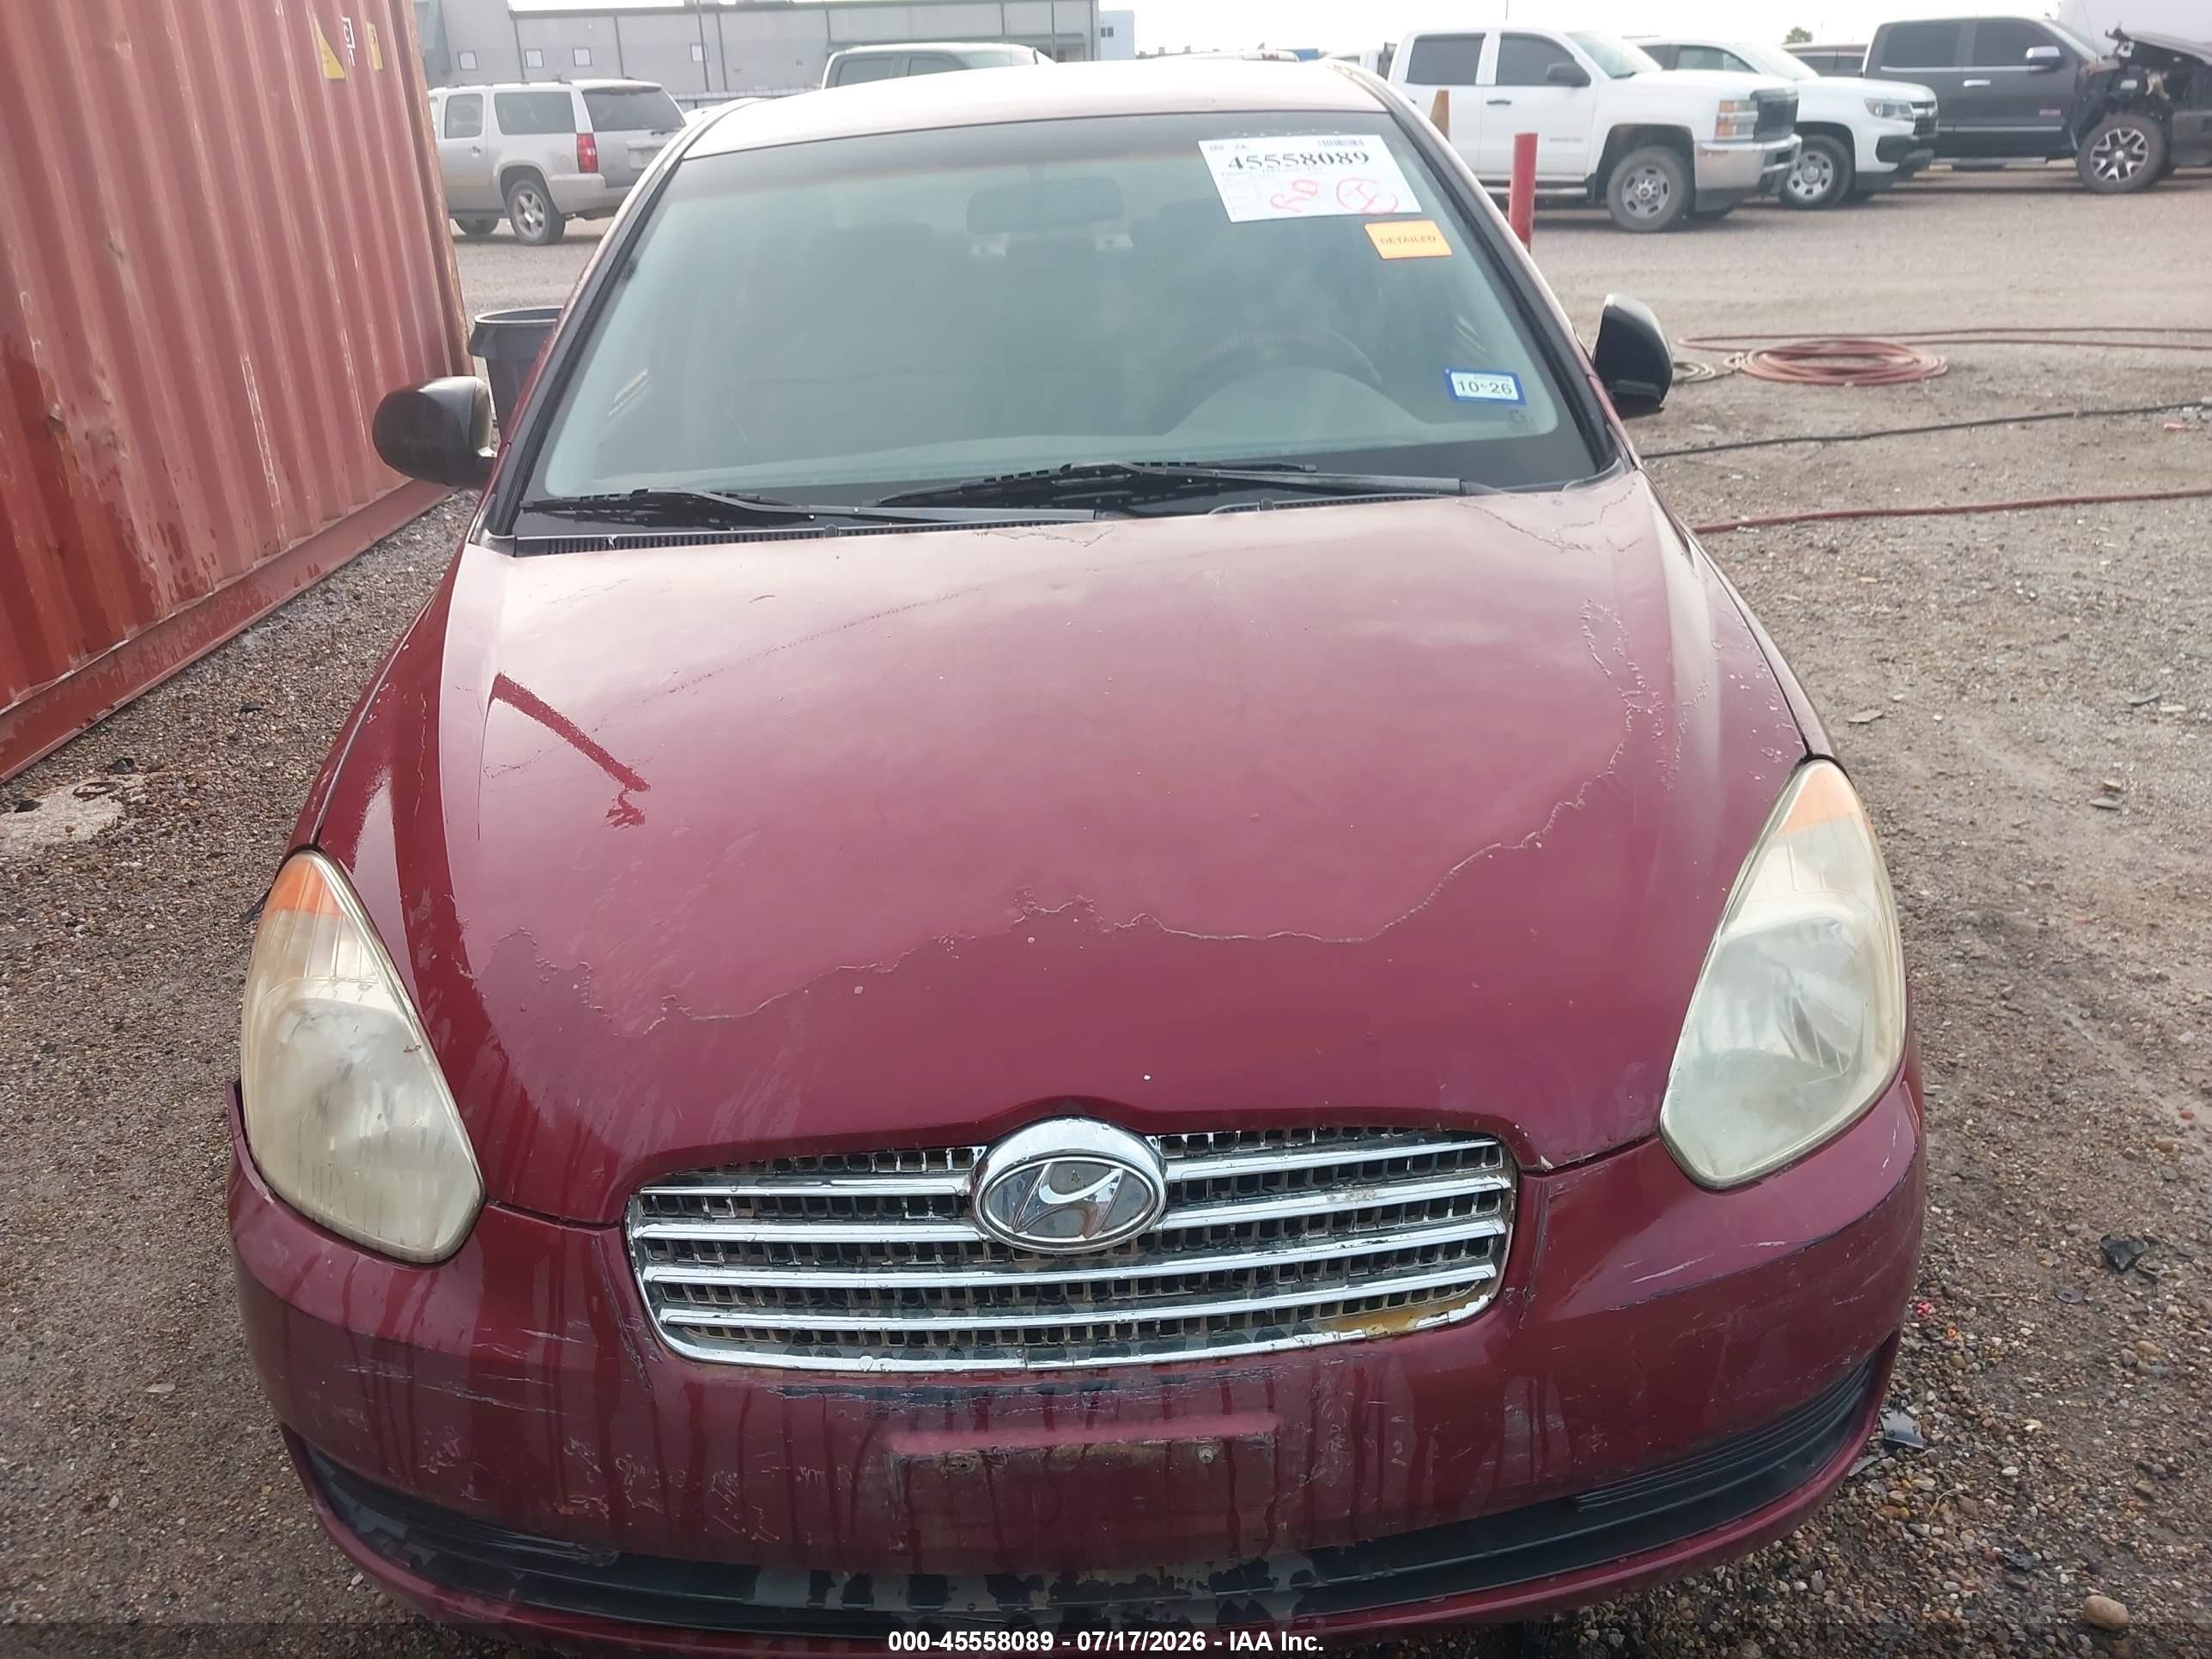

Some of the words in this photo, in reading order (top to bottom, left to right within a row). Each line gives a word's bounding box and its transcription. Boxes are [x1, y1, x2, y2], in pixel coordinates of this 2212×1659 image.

[1228, 150, 1370, 171] 45558089
[1379, 234, 1437, 246] DETAILED
[1457, 380, 1480, 392] 10
[1489, 382, 1512, 395] 26
